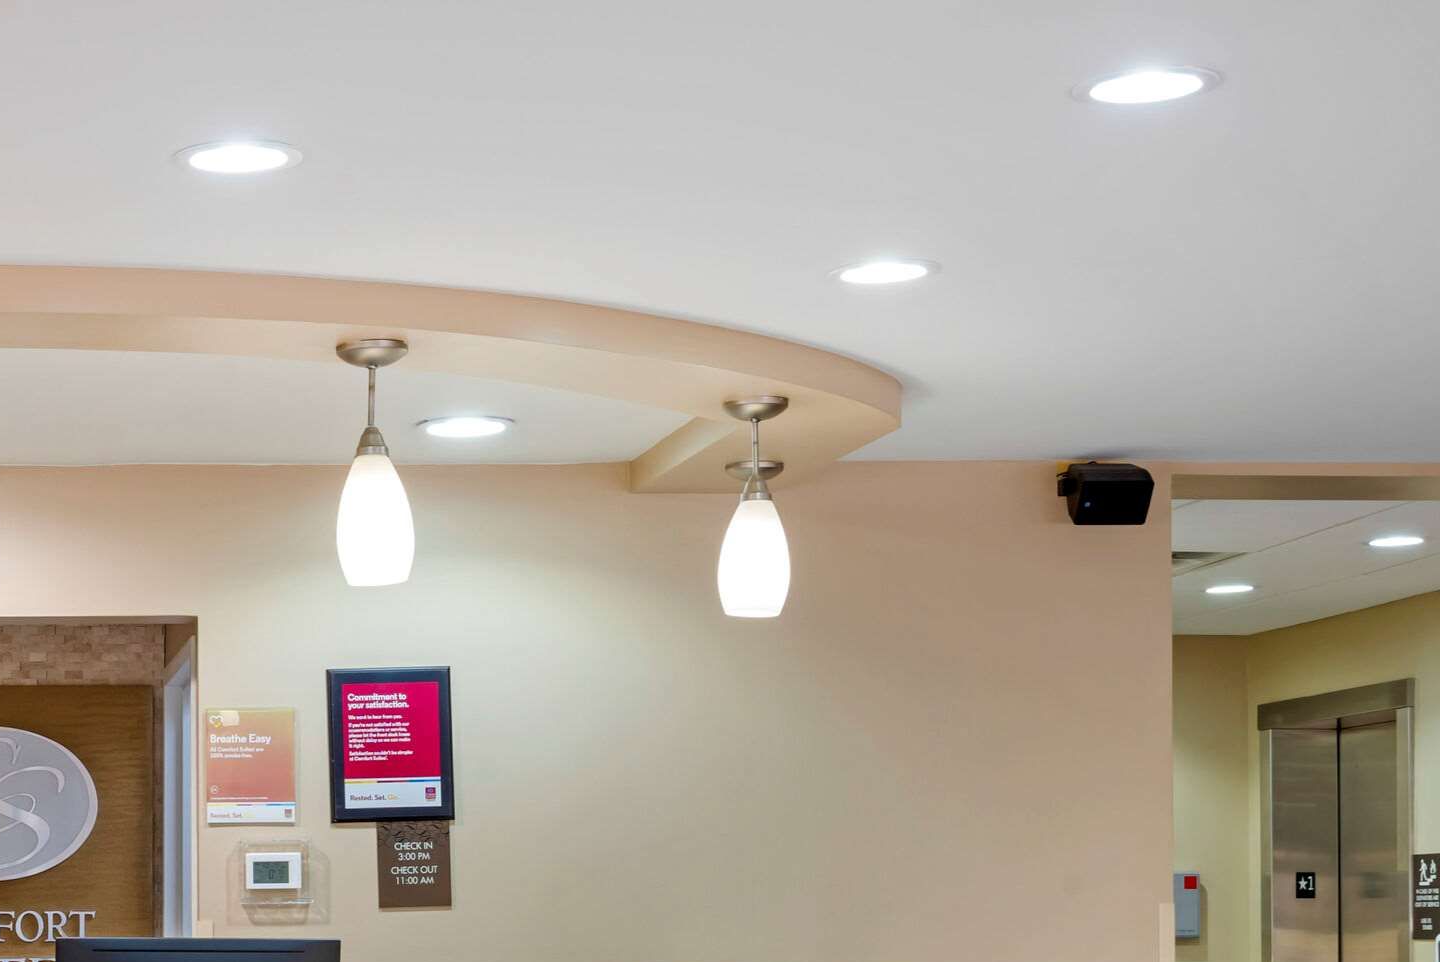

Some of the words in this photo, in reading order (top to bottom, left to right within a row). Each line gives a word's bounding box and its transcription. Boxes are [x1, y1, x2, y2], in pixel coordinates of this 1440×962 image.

[347, 692, 398, 701] Commitment
[347, 702, 364, 711] your
[210, 734, 247, 743] Breathe
[248, 733, 272, 745] Easy
[394, 842, 422, 851] CHECK
[423, 841, 433, 850] IN
[398, 852, 416, 861] 3:00
[417, 852, 431, 861] PM
[391, 866, 419, 875] CHECK
[420, 865, 438, 874] OUT
[396, 876, 418, 885] 11:00
[420, 876, 435, 884] AM
